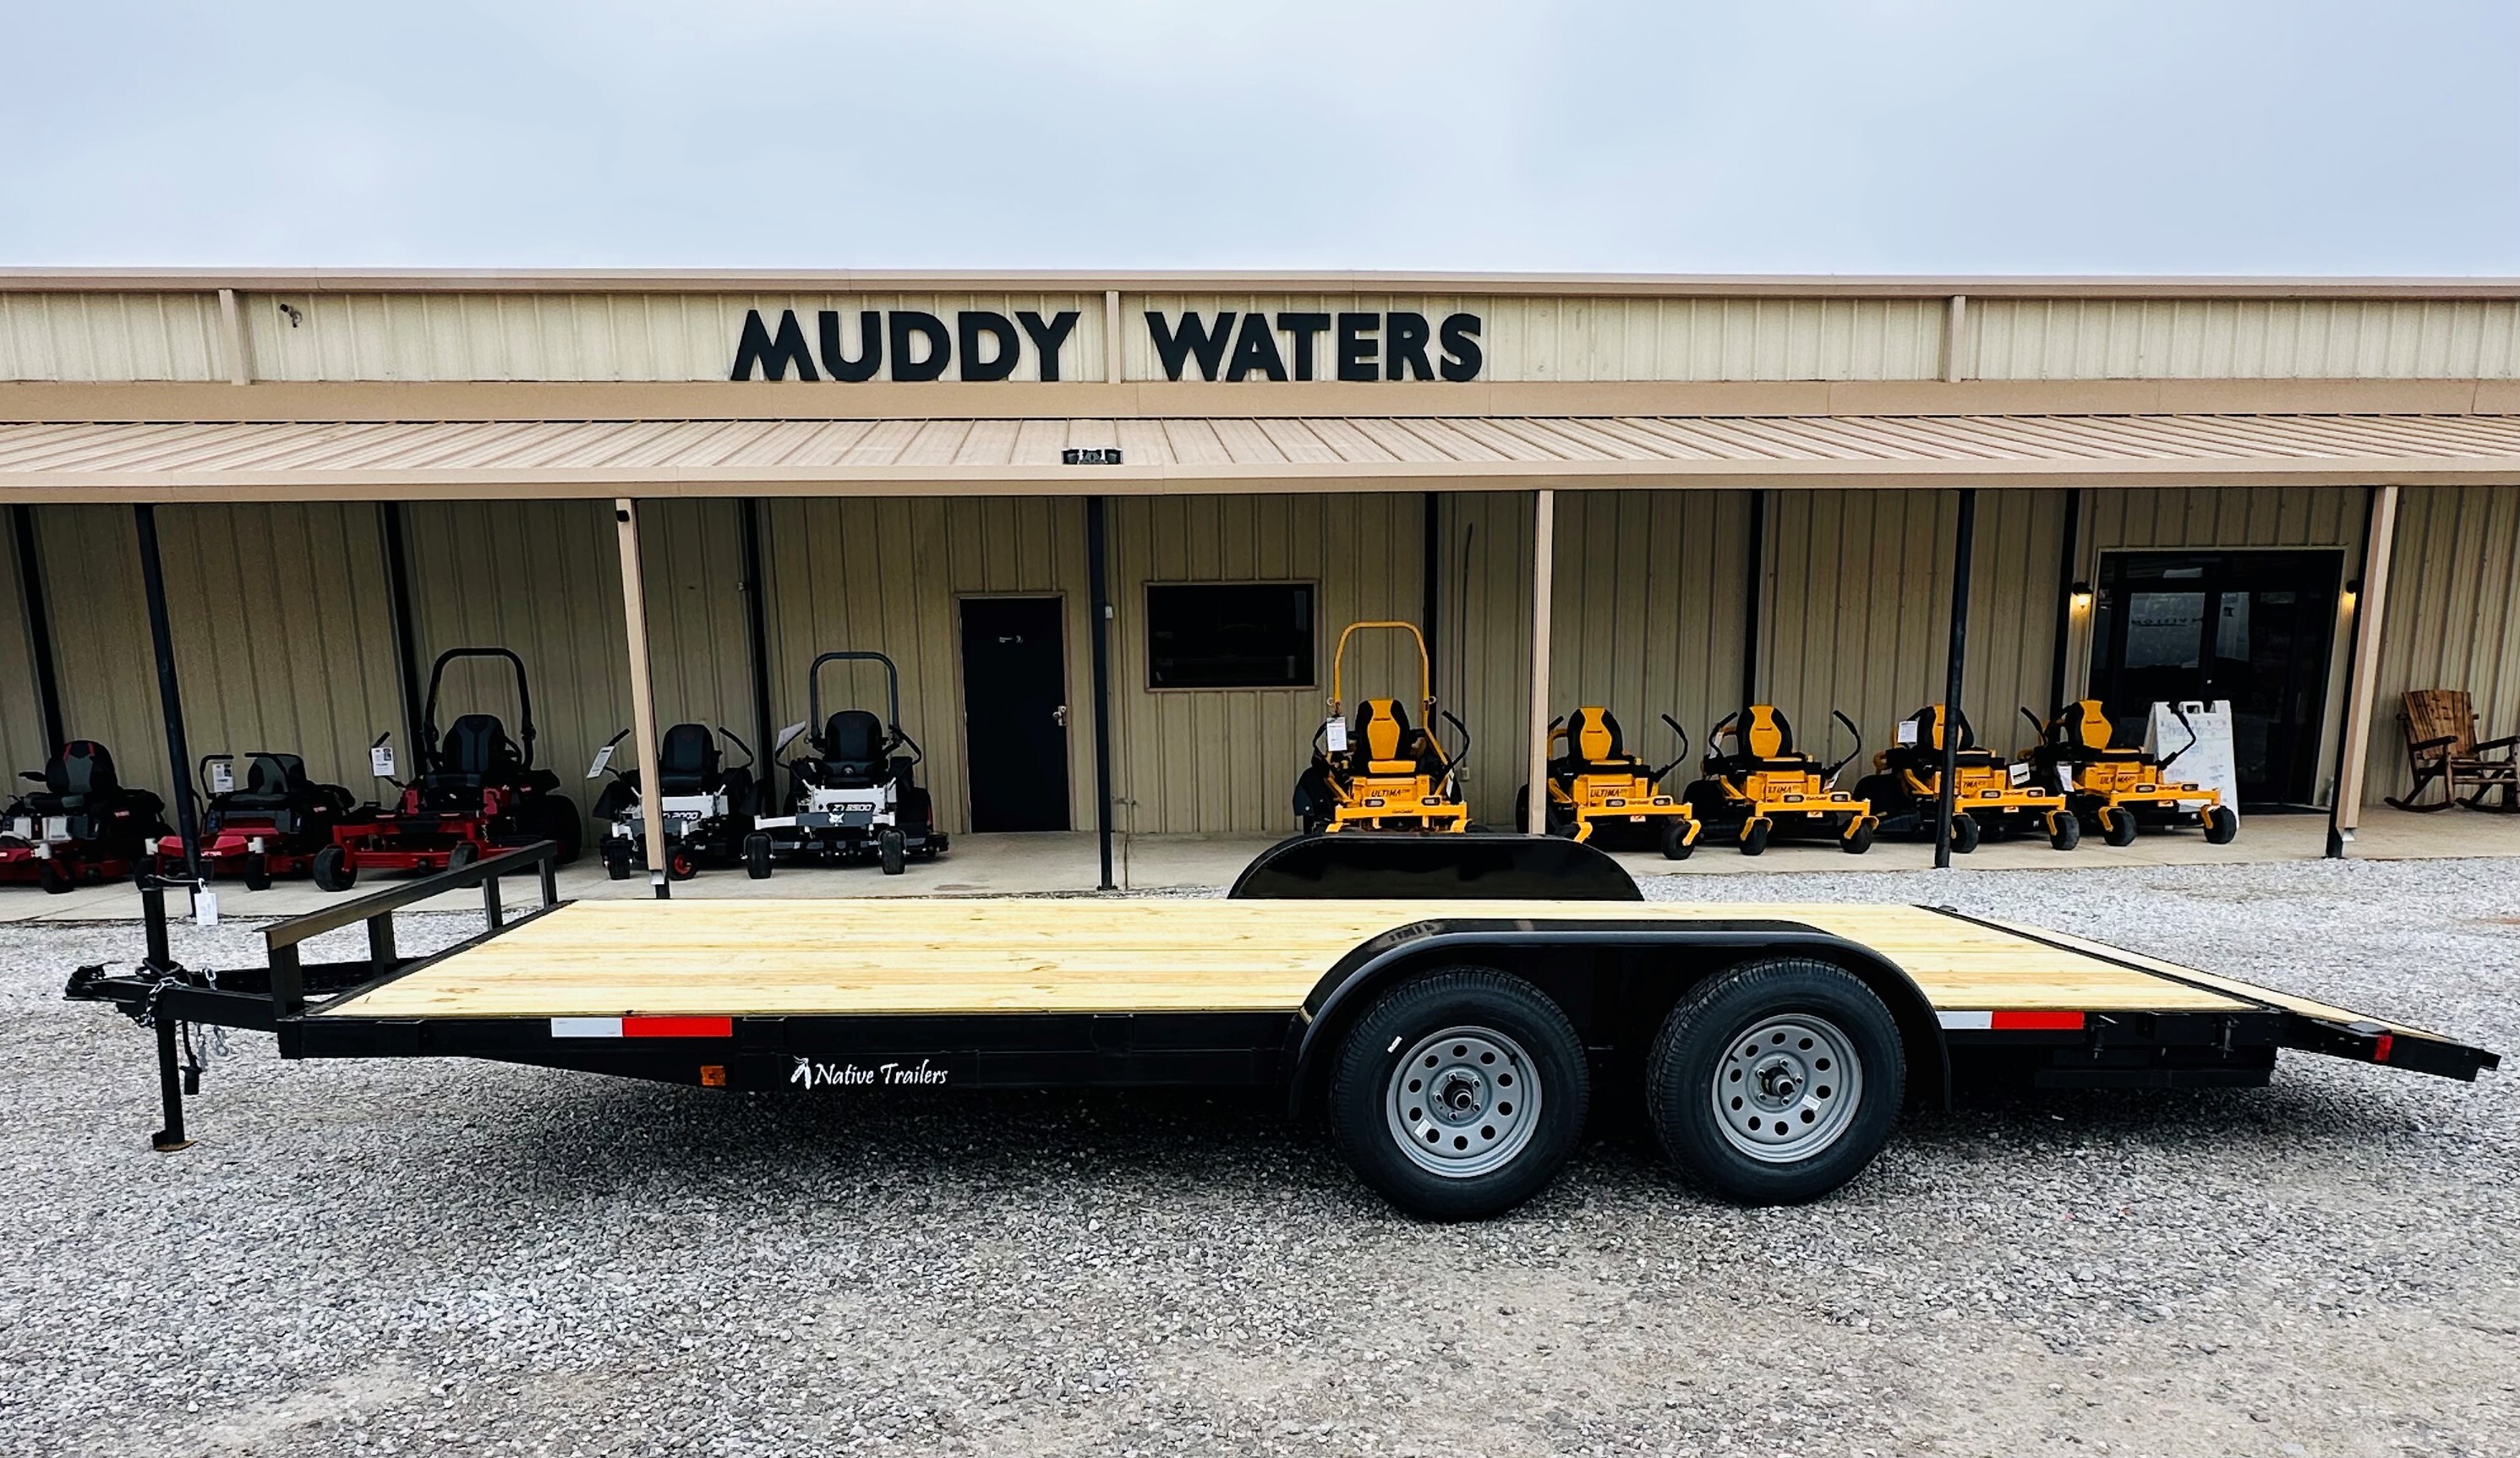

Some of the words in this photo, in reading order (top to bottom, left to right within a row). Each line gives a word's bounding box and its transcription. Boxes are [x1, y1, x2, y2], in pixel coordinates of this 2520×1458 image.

[730, 310, 1081, 381] MUDDY
[1144, 311, 1482, 381] WATERS
[1370, 789, 1401, 797] ULTIMA
[1590, 789, 1620, 797] ULTIMA
[814, 1063, 874, 1085] Native
[880, 1058, 948, 1084] Trailers
